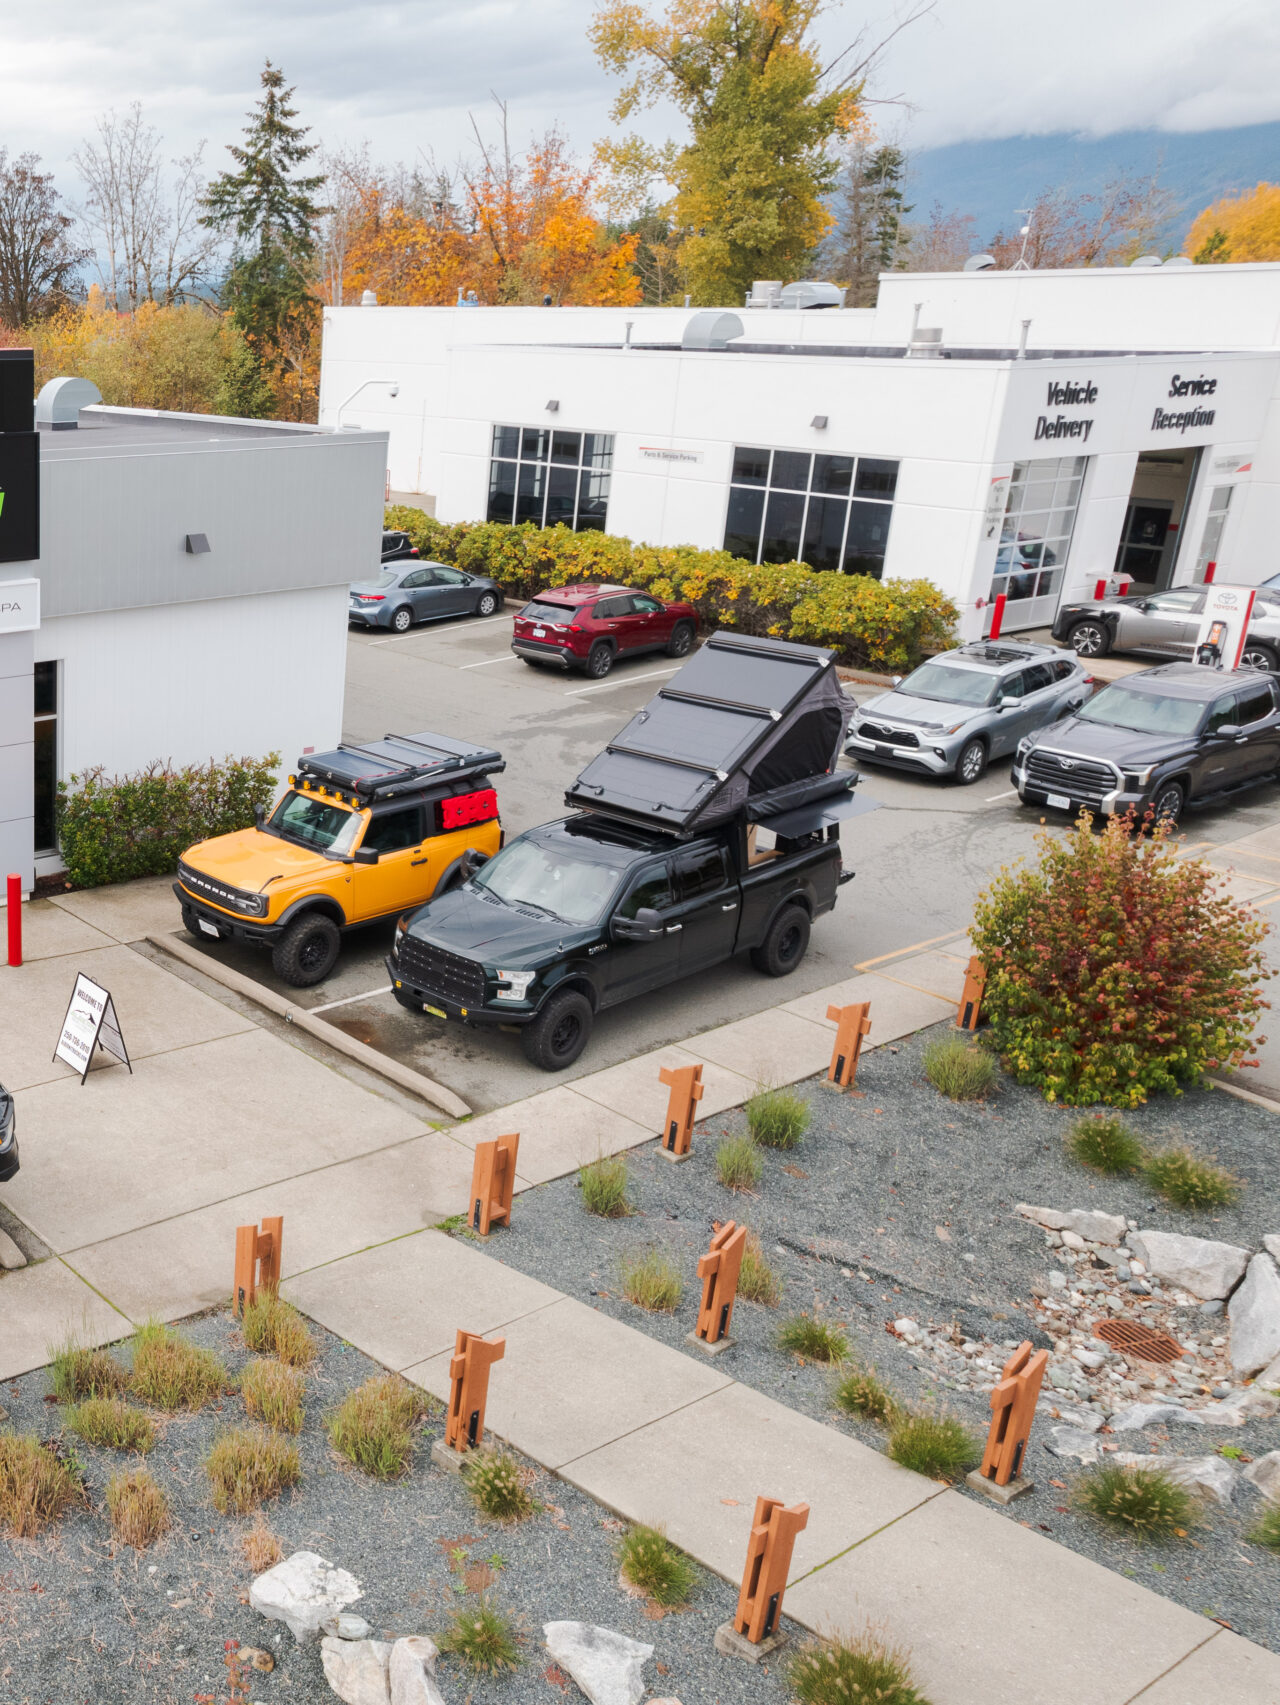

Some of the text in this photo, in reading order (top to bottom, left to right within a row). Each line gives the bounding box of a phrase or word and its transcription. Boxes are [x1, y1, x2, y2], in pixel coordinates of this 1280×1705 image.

[1047, 380, 1098, 406] Vehicle
[1168, 374, 1217, 398] Service
[1034, 415, 1094, 443] Delivery
[1151, 405, 1216, 434] Reception
[1213, 603, 1238, 611] TOYOTA
[190, 876, 235, 900] BRONCO
[77, 988, 98, 1008] WELCOME
